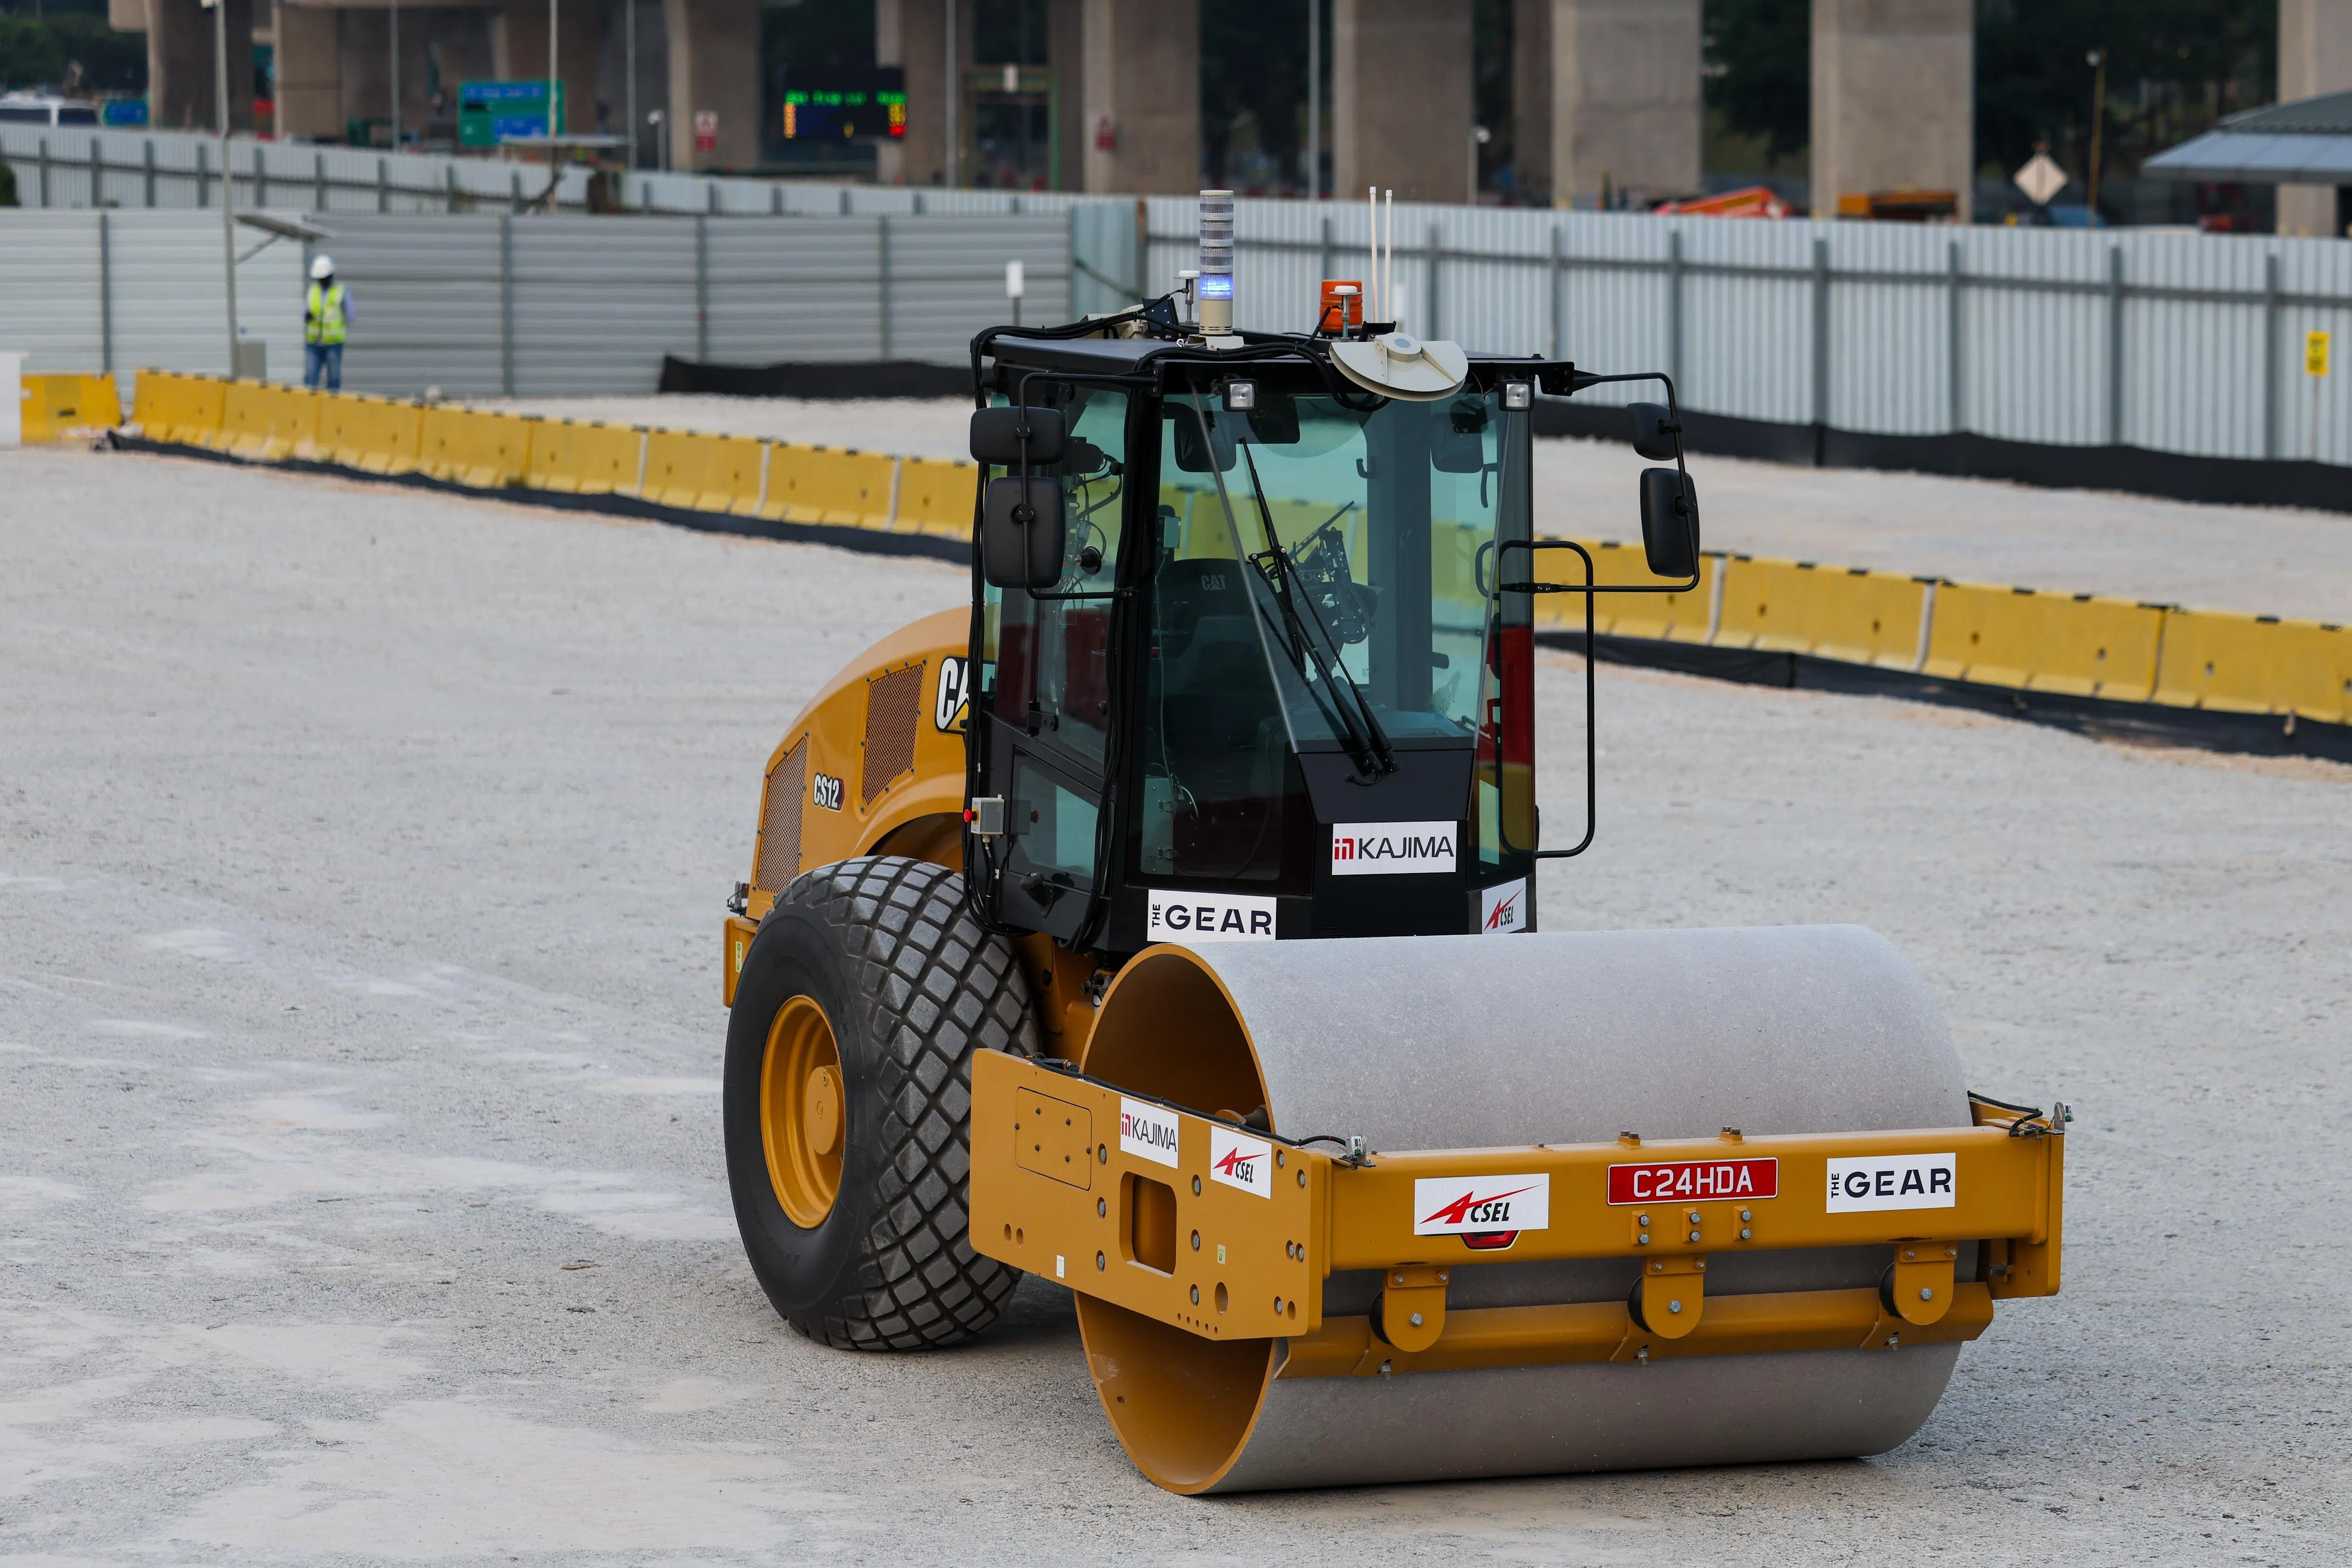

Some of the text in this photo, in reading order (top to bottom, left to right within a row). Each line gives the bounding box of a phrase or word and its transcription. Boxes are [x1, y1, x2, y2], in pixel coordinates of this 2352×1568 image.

[1201, 575, 1226, 591] CAT
[814, 774, 839, 808] CS12
[1358, 836, 1454, 859] KAJIMA
[1152, 904, 1272, 935] THE GEAR
[1131, 1116, 1177, 1152] KAJIMA
[1633, 1165, 1753, 1197] C24HDA
[1831, 1168, 1952, 1198] THE GEAR
